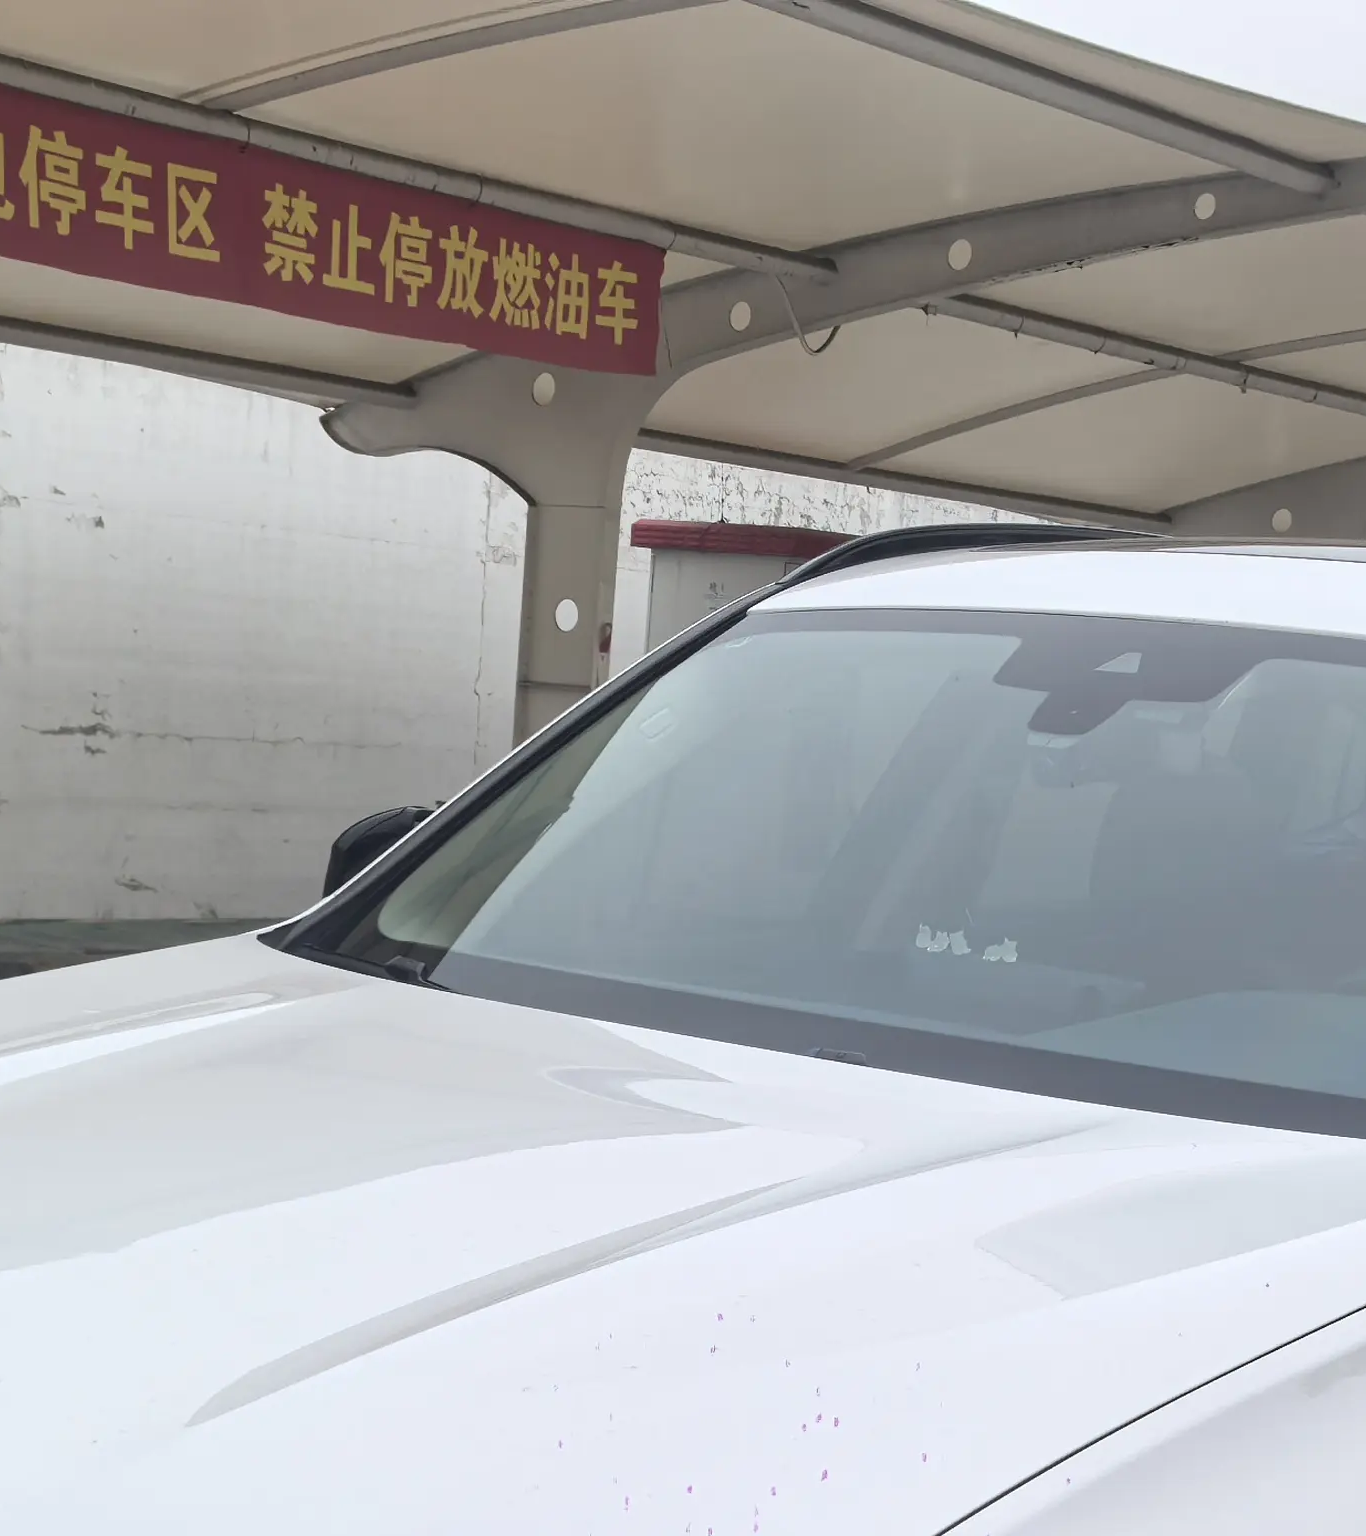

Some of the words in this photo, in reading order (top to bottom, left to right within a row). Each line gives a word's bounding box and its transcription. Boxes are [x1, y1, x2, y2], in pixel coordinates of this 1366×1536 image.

[262, 183, 639, 346] 禁止停放燃油车
